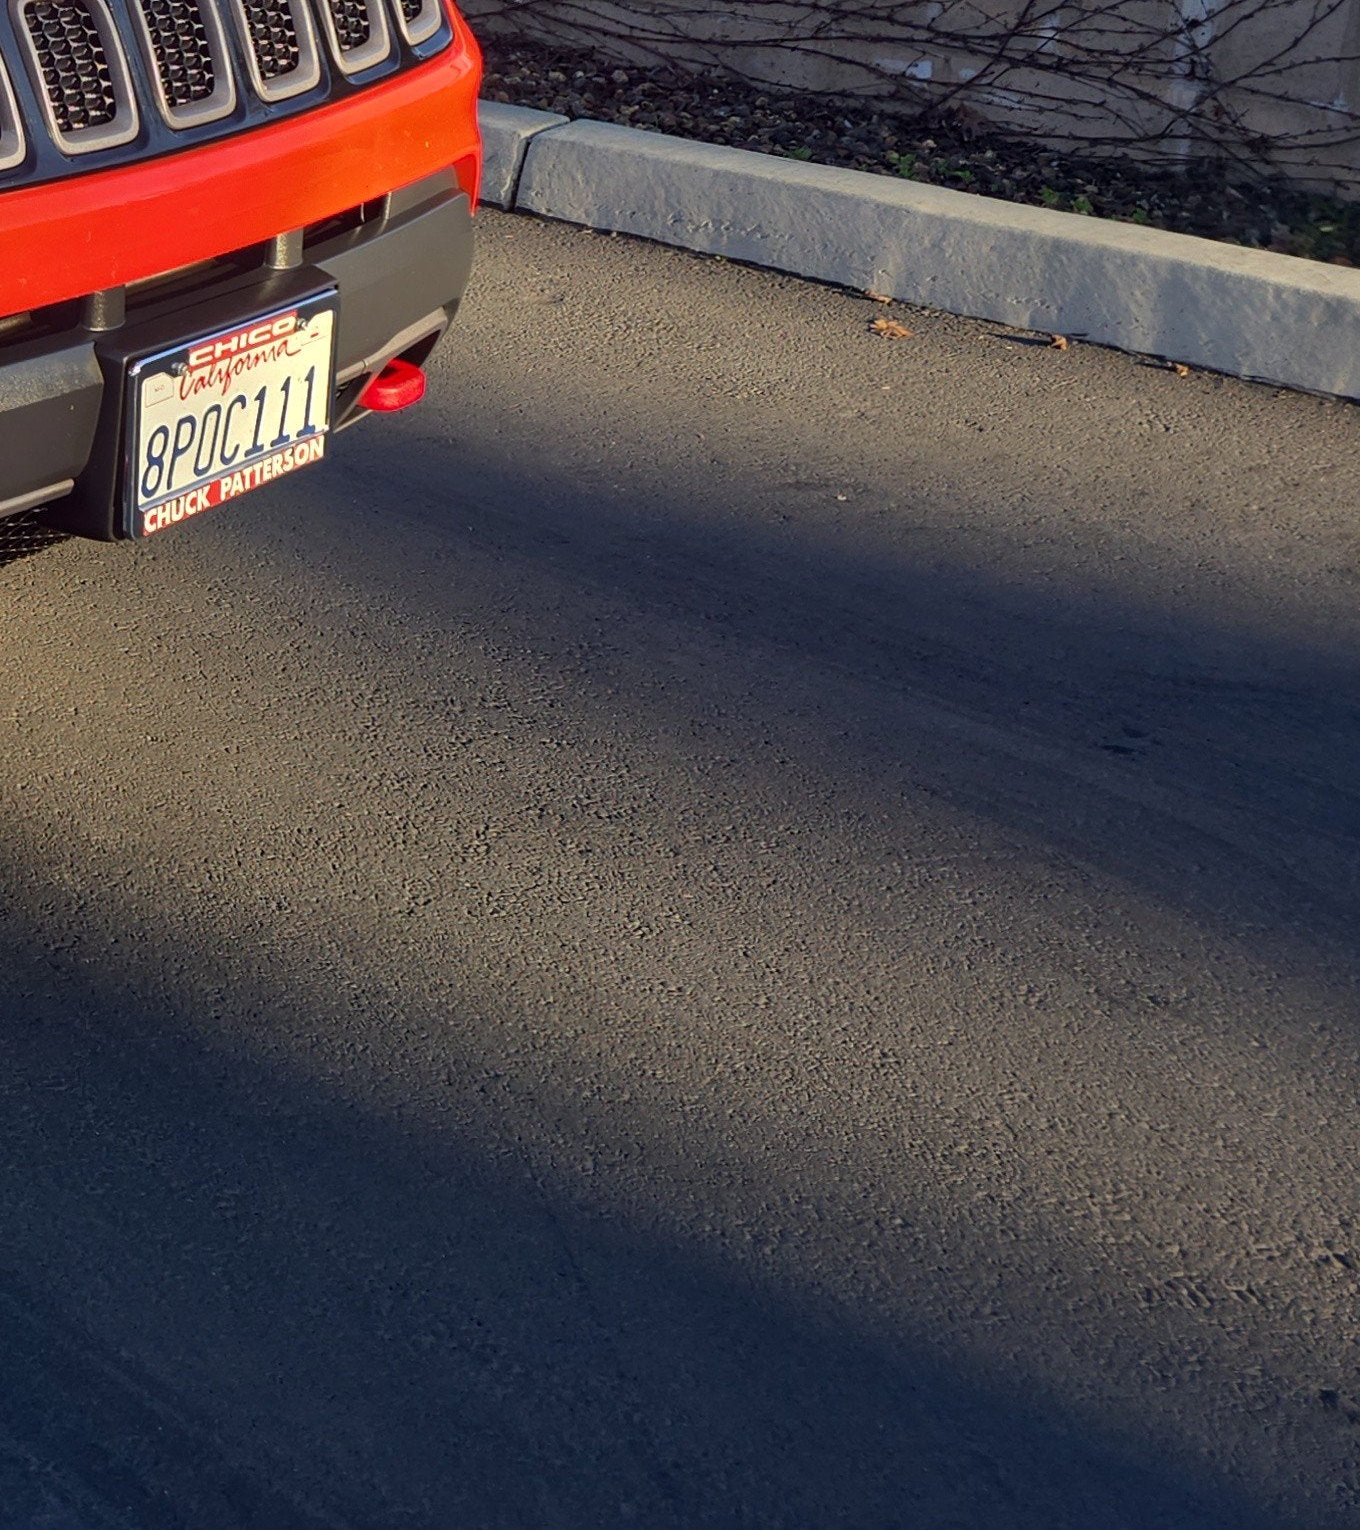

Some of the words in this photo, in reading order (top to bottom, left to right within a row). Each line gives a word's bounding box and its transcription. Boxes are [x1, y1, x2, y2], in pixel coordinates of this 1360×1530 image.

[179, 338, 302, 401] California
[188, 315, 298, 366] CHICO
[140, 365, 316, 499] 8POC111
[143, 486, 211, 534] CHUCK
[220, 436, 324, 500] PATTERSON
